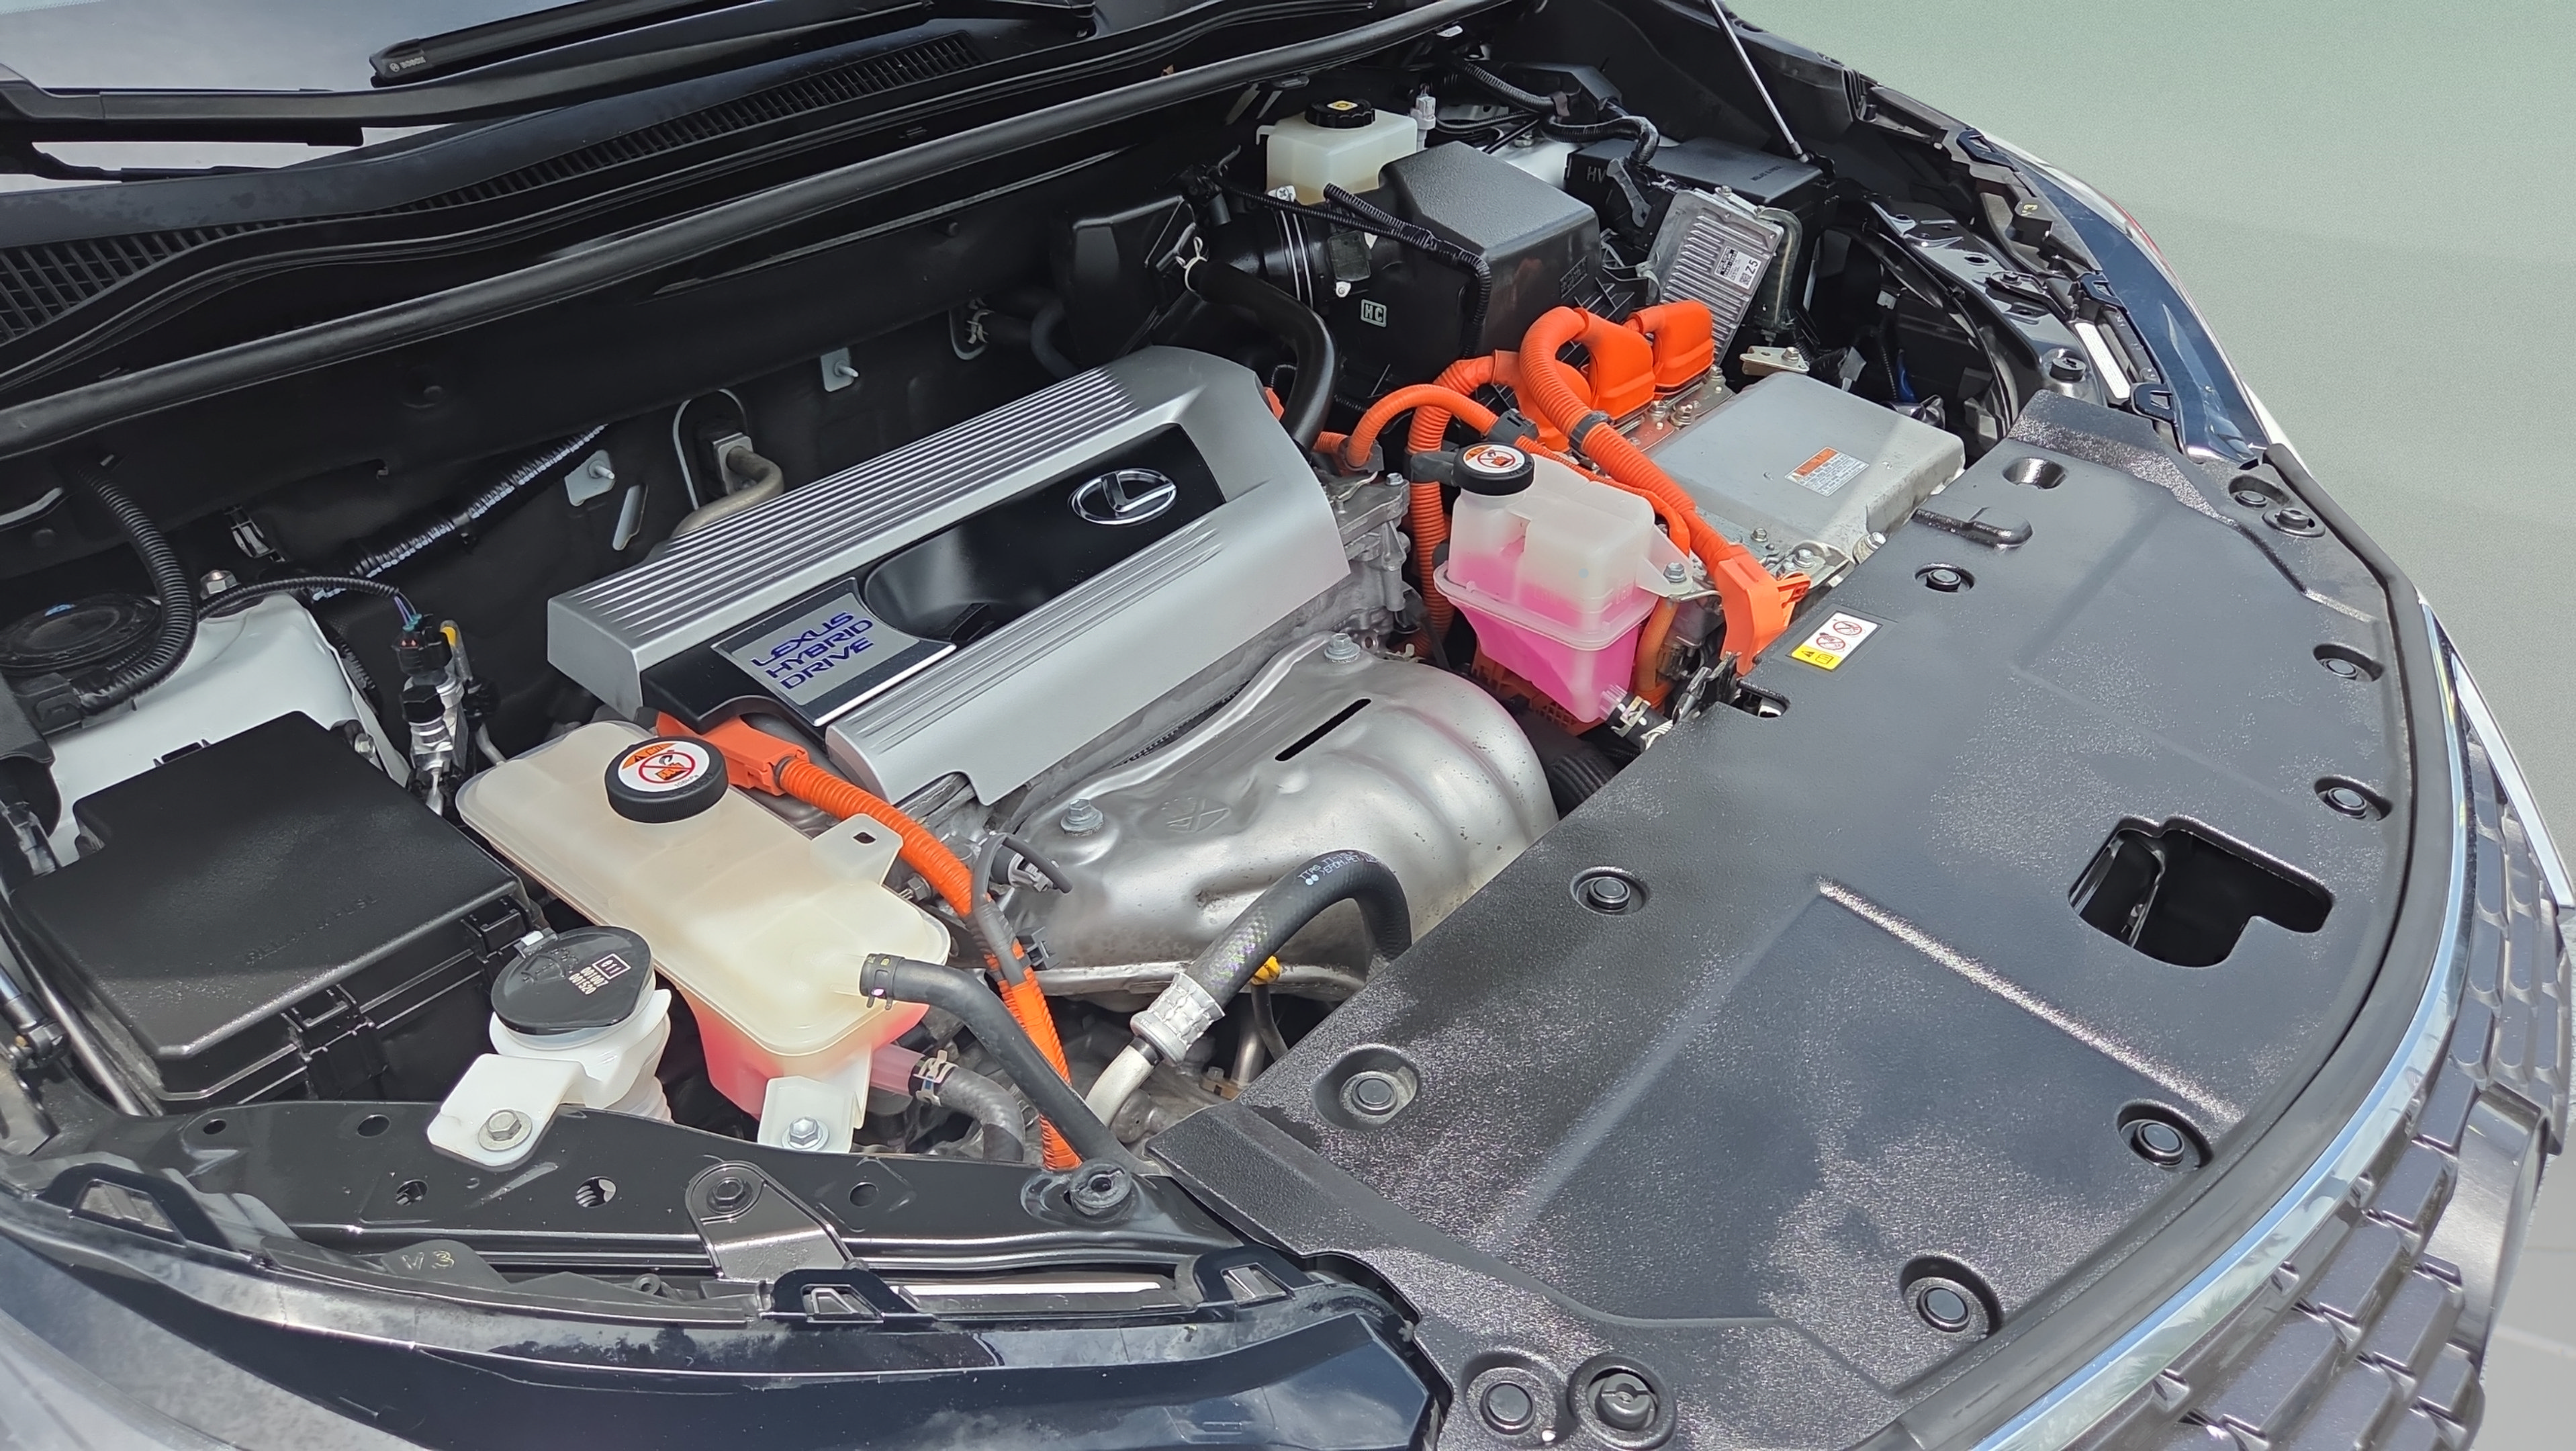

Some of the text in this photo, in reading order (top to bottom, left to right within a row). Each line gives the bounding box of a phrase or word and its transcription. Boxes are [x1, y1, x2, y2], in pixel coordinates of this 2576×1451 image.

[1745, 259, 1758, 275] Z5
[1365, 304, 1383, 322] HC
[751, 611, 854, 666] LEXUS
[766, 619, 873, 678] HYBRID
[780, 637, 874, 690] DRIVE
[569, 973, 597, 995] 001520
[580, 967, 609, 987] 001007
